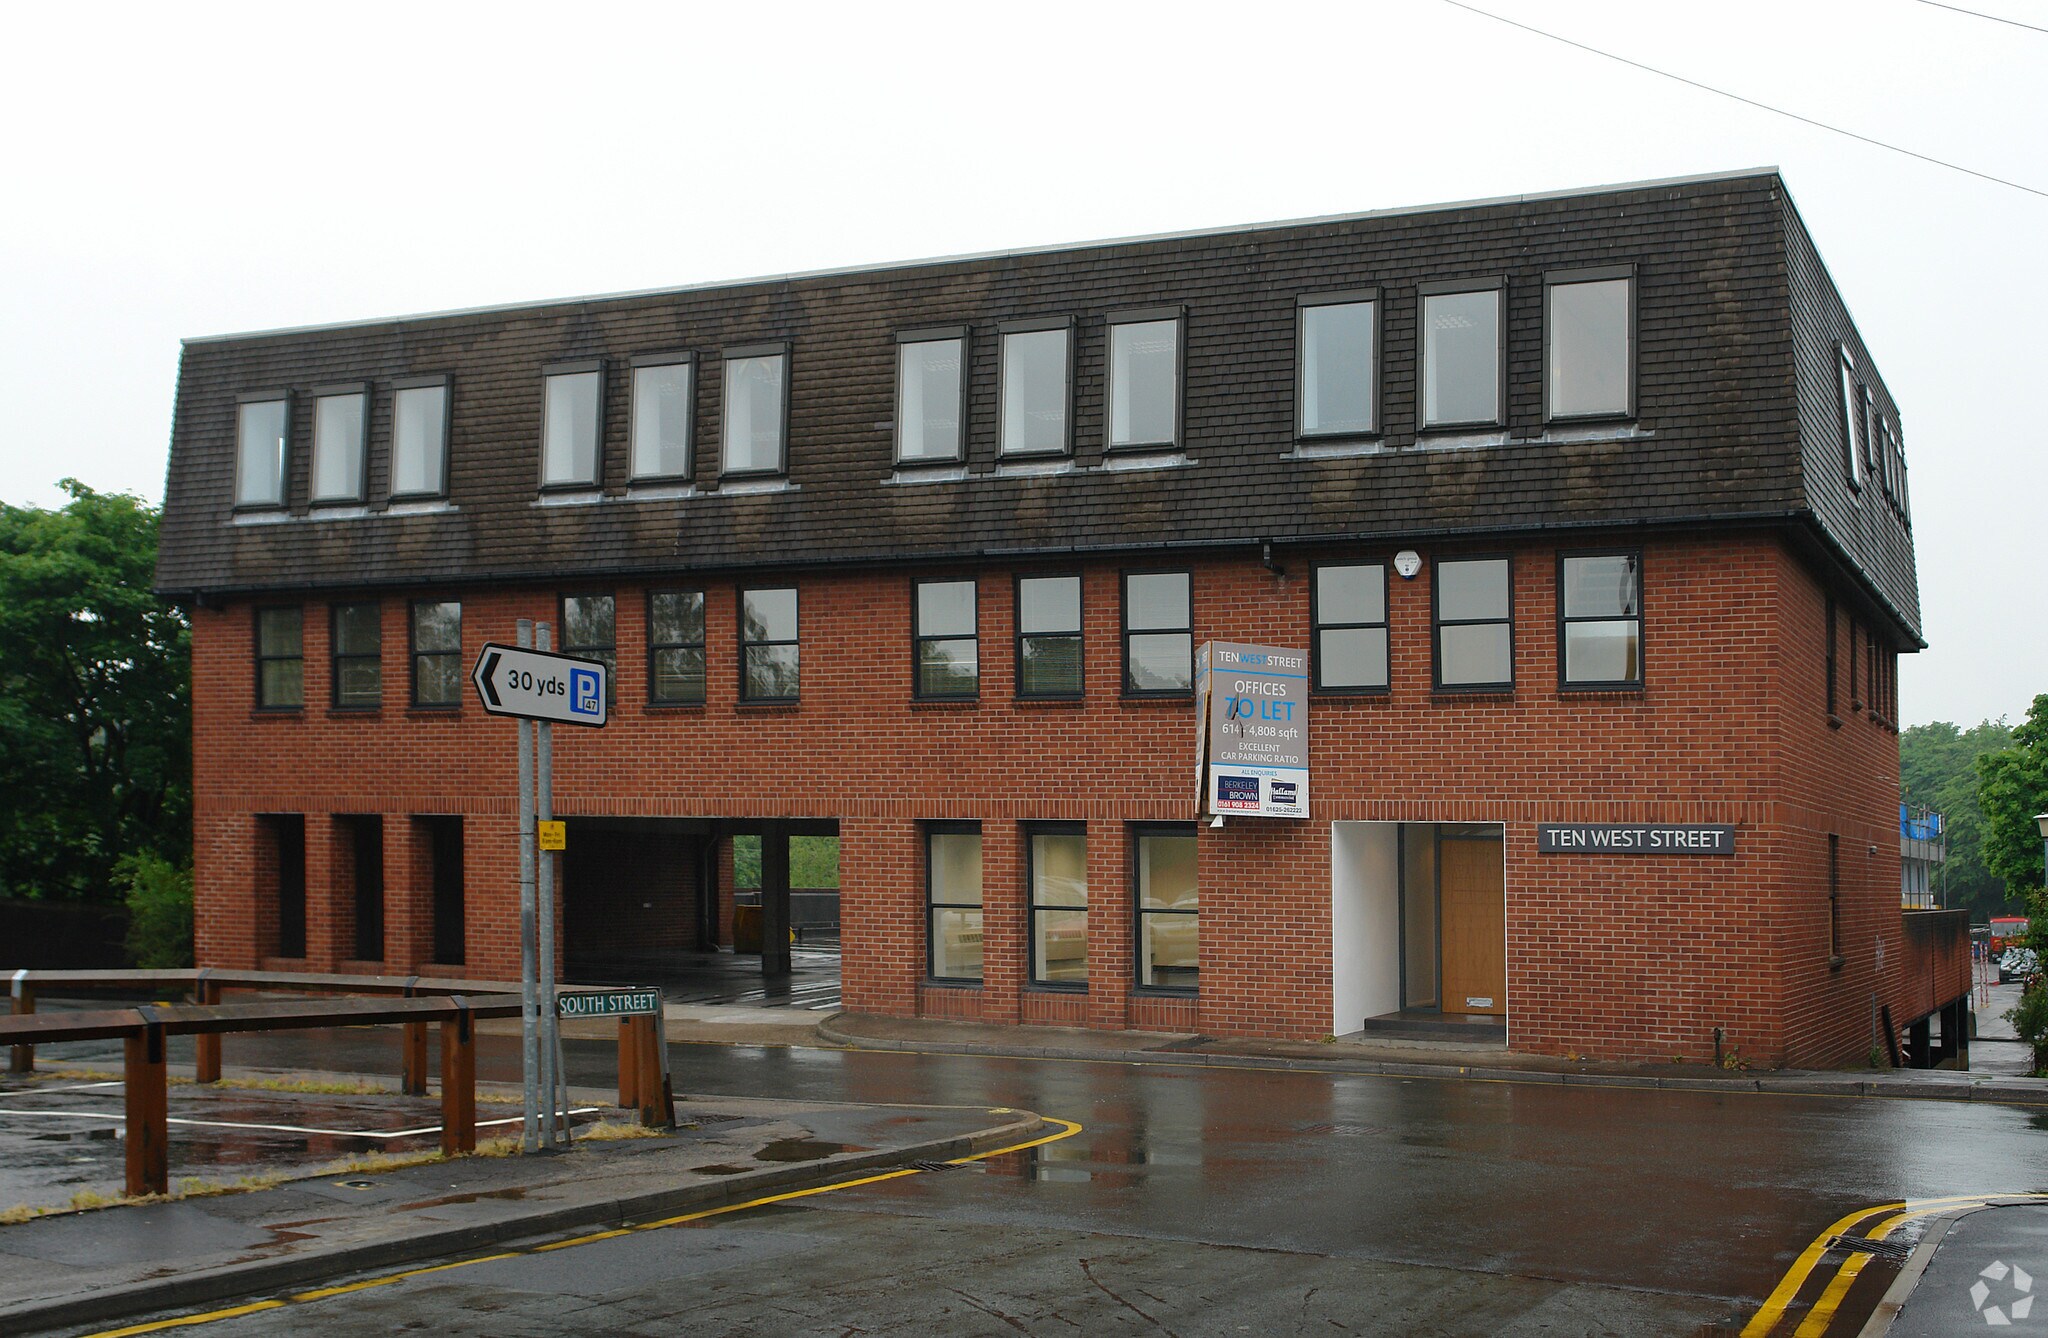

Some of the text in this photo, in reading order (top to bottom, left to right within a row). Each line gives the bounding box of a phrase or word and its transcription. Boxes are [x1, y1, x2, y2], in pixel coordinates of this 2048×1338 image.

[508, 670, 565, 697] 30 yds
[1235, 680, 1287, 697] OFFICES
[577, 674, 596, 709] P
[585, 700, 597, 710] 47
[1225, 697, 1296, 721] TO LET
[1249, 726, 1276, 737] 4,808
[1279, 728, 1298, 740] sqft
[1239, 742, 1281, 752] EXCELLENT
[1221, 751, 1299, 764] CAR PARKING RATIO
[1224, 780, 1258, 789] BERKELEY
[1229, 791, 1258, 800] BROWN
[1547, 829, 1724, 848] TEN WEST STREET
[559, 993, 655, 1013] SOUTH STREET
